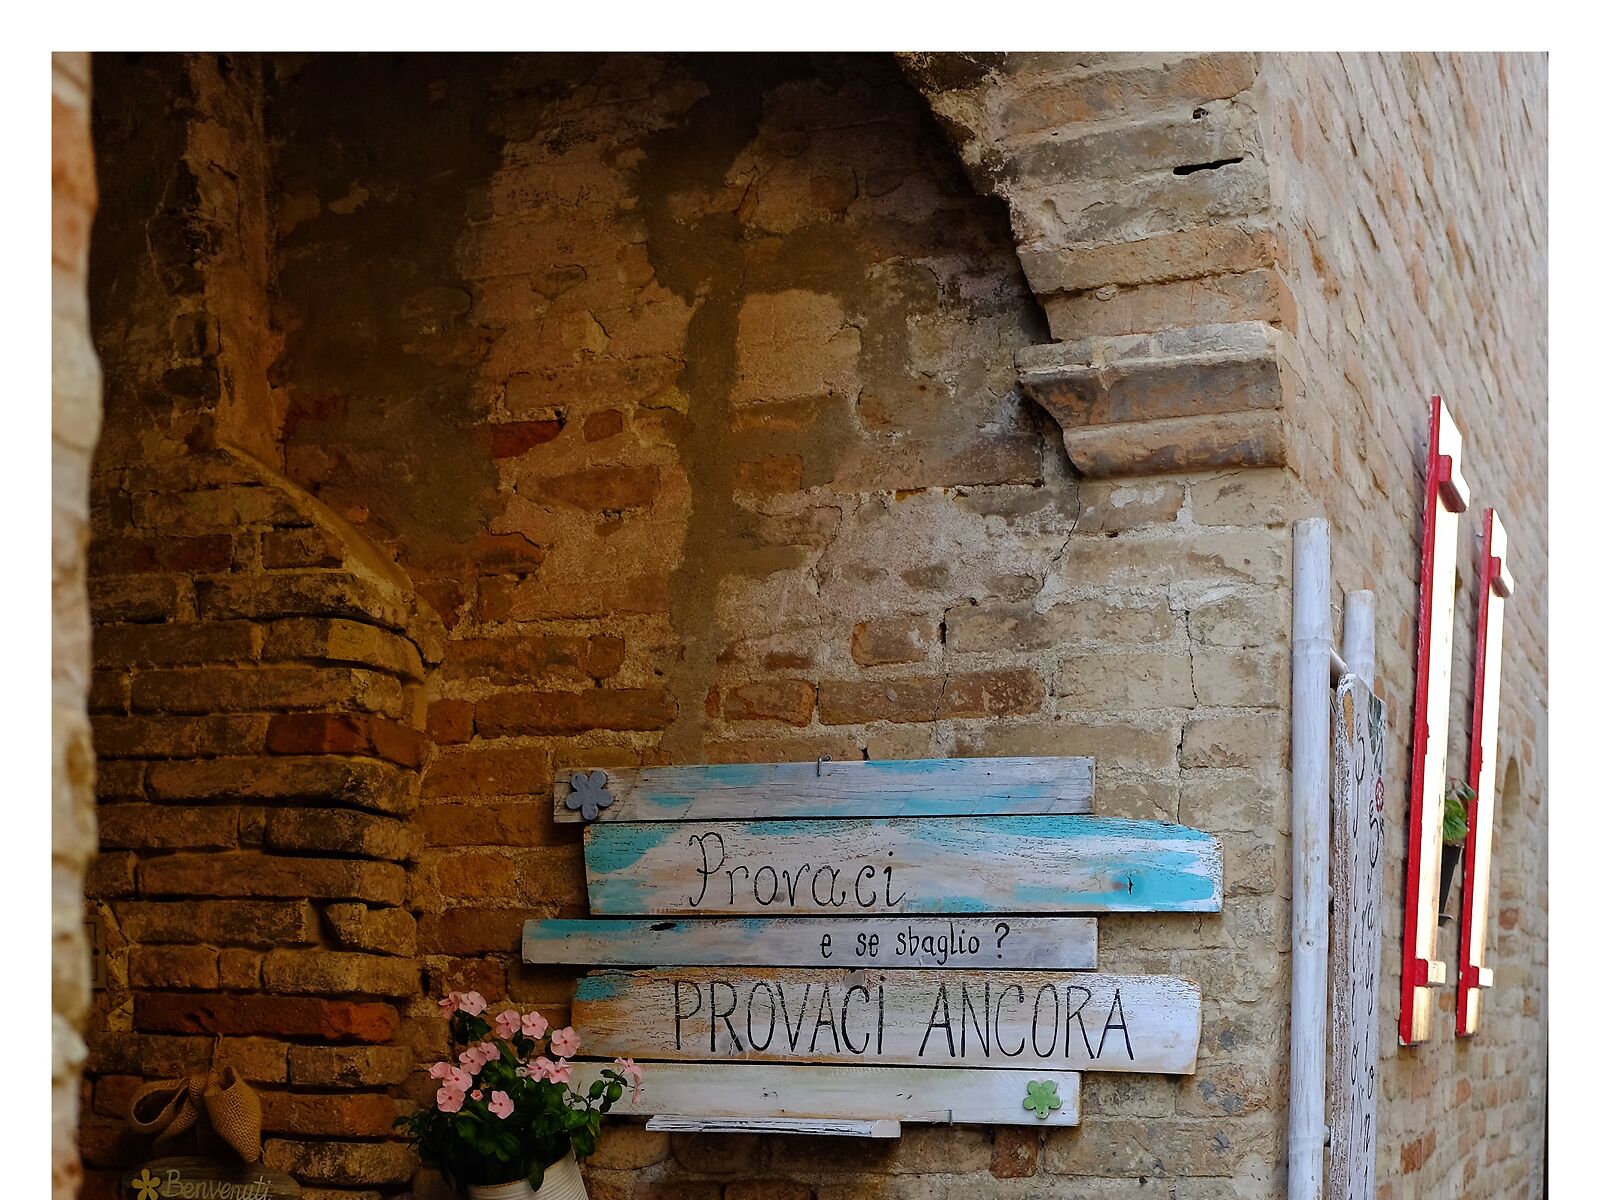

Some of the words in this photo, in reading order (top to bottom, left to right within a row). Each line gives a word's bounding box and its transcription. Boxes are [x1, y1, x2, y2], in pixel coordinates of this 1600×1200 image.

[688, 831, 906, 910] Provaci
[819, 934, 833, 958] e
[855, 933, 880, 957] se
[895, 930, 980, 965] sbaglio
[993, 922, 1011, 959] ?
[673, 976, 887, 1057] PROVACI
[918, 984, 1136, 1061] ANCORA
